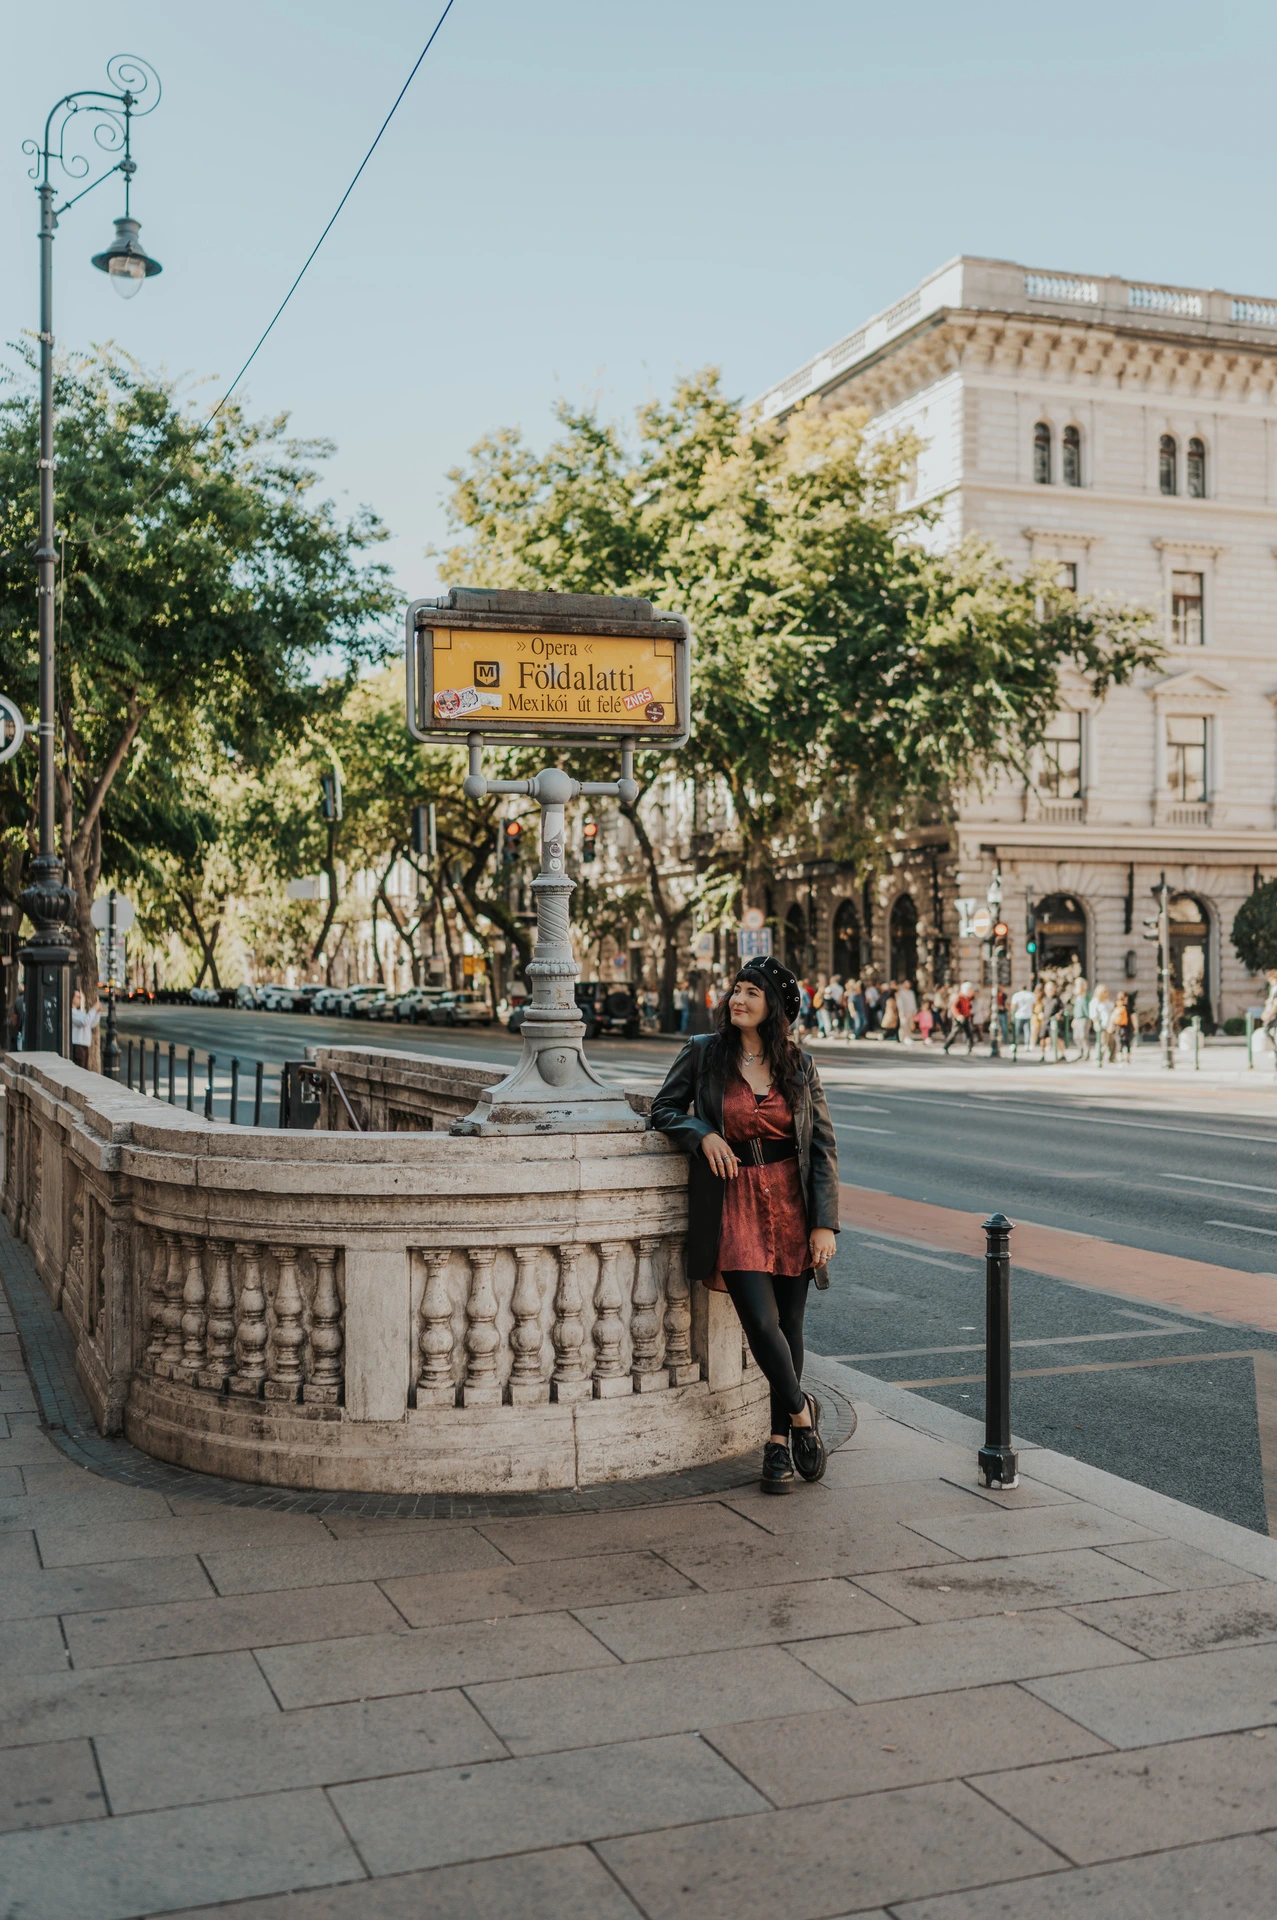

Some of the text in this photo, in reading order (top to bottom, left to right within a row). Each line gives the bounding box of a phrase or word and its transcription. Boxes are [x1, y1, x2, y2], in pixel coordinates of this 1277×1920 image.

[531, 637, 577, 660] Opera
[479, 666, 494, 677] M
[518, 661, 635, 691] Földalatti
[508, 693, 621, 713] Mexikói út felé
[623, 689, 652, 710] ZNRS
